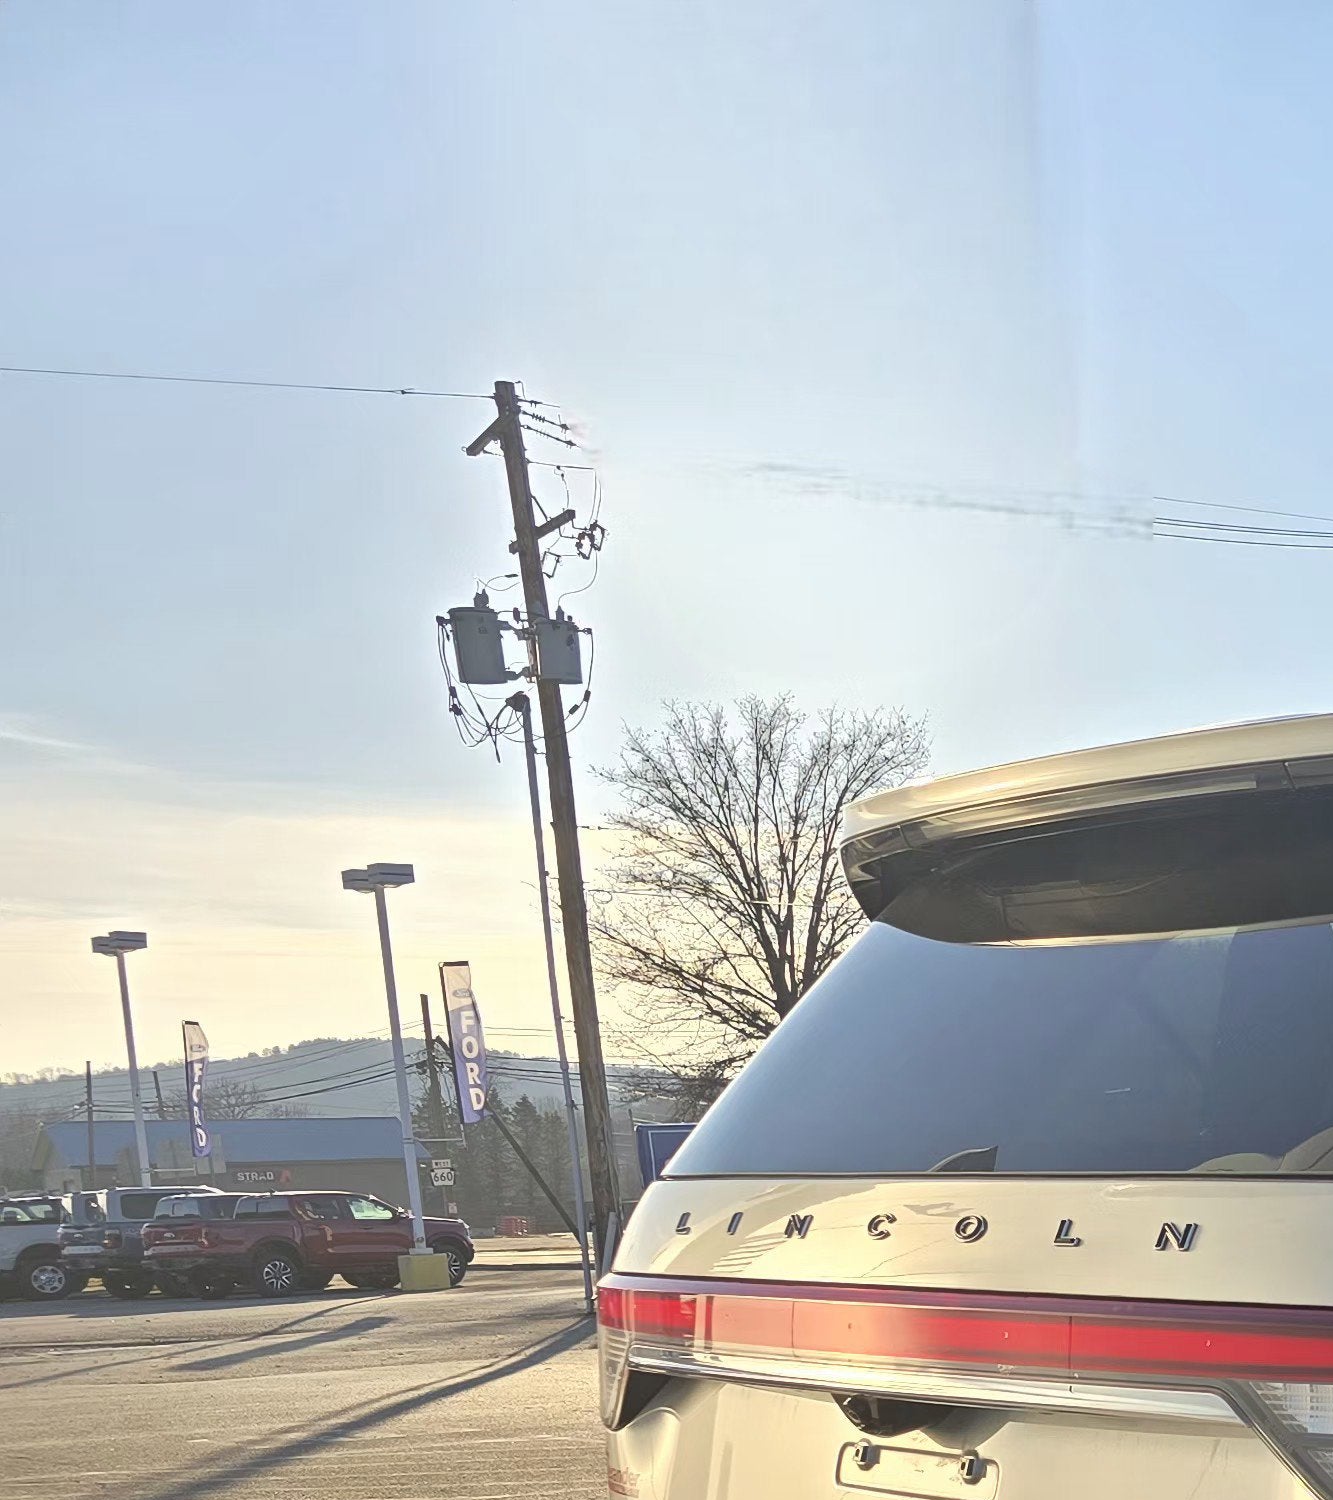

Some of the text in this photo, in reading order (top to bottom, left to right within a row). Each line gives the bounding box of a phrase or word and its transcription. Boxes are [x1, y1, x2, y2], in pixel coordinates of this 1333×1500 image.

[460, 1010, 485, 1111] FORD
[433, 1172, 453, 1182] 660
[675, 1211, 1201, 1252] LINCOLN
